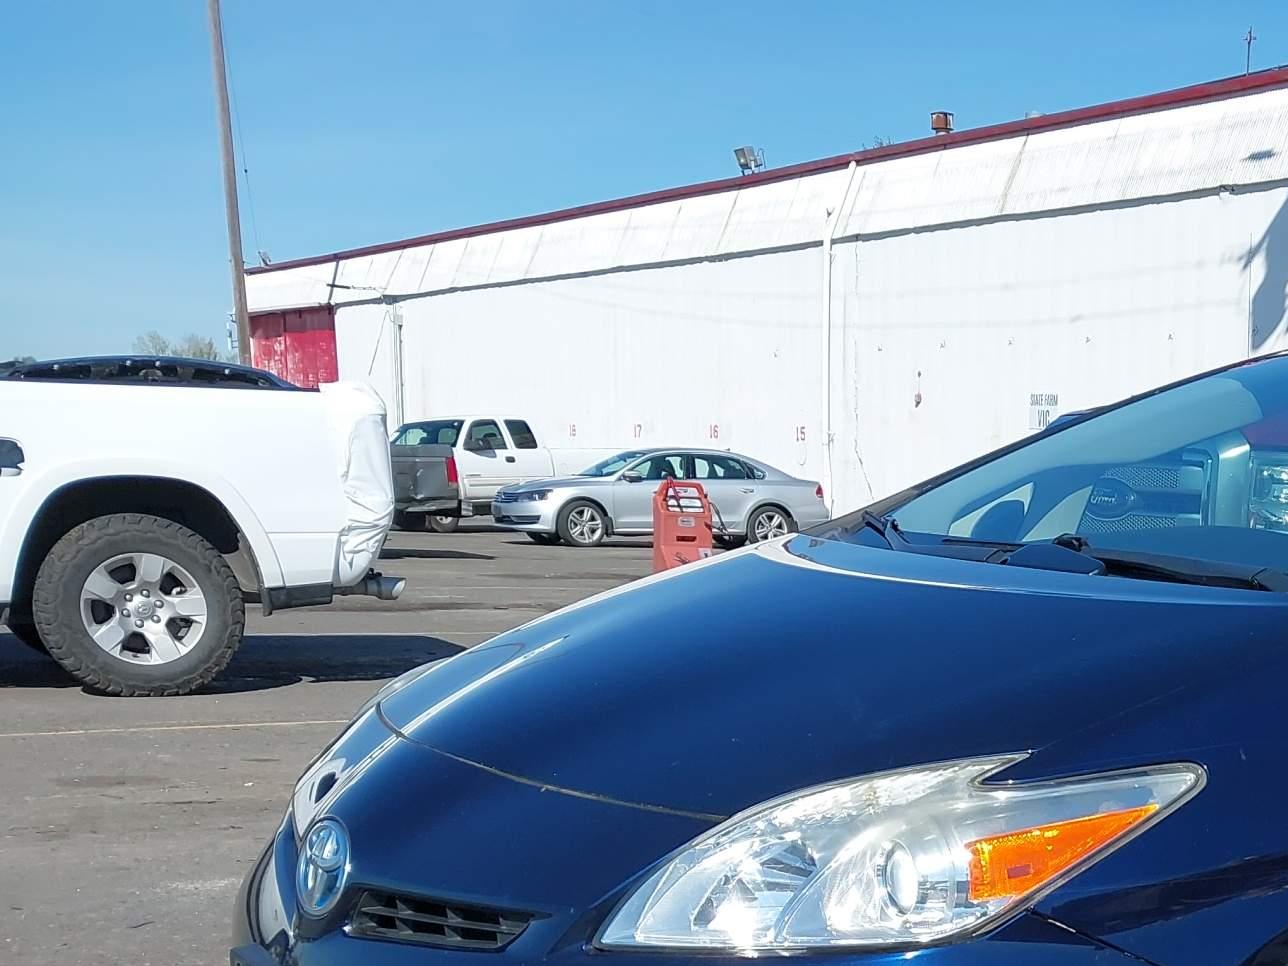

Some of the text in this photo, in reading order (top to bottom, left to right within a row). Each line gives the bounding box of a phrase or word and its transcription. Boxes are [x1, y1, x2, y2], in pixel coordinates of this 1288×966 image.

[1030, 393, 1058, 406] STATE FARM
[633, 423, 643, 438] 17
[709, 424, 719, 439] 16
[795, 426, 806, 442] 15
